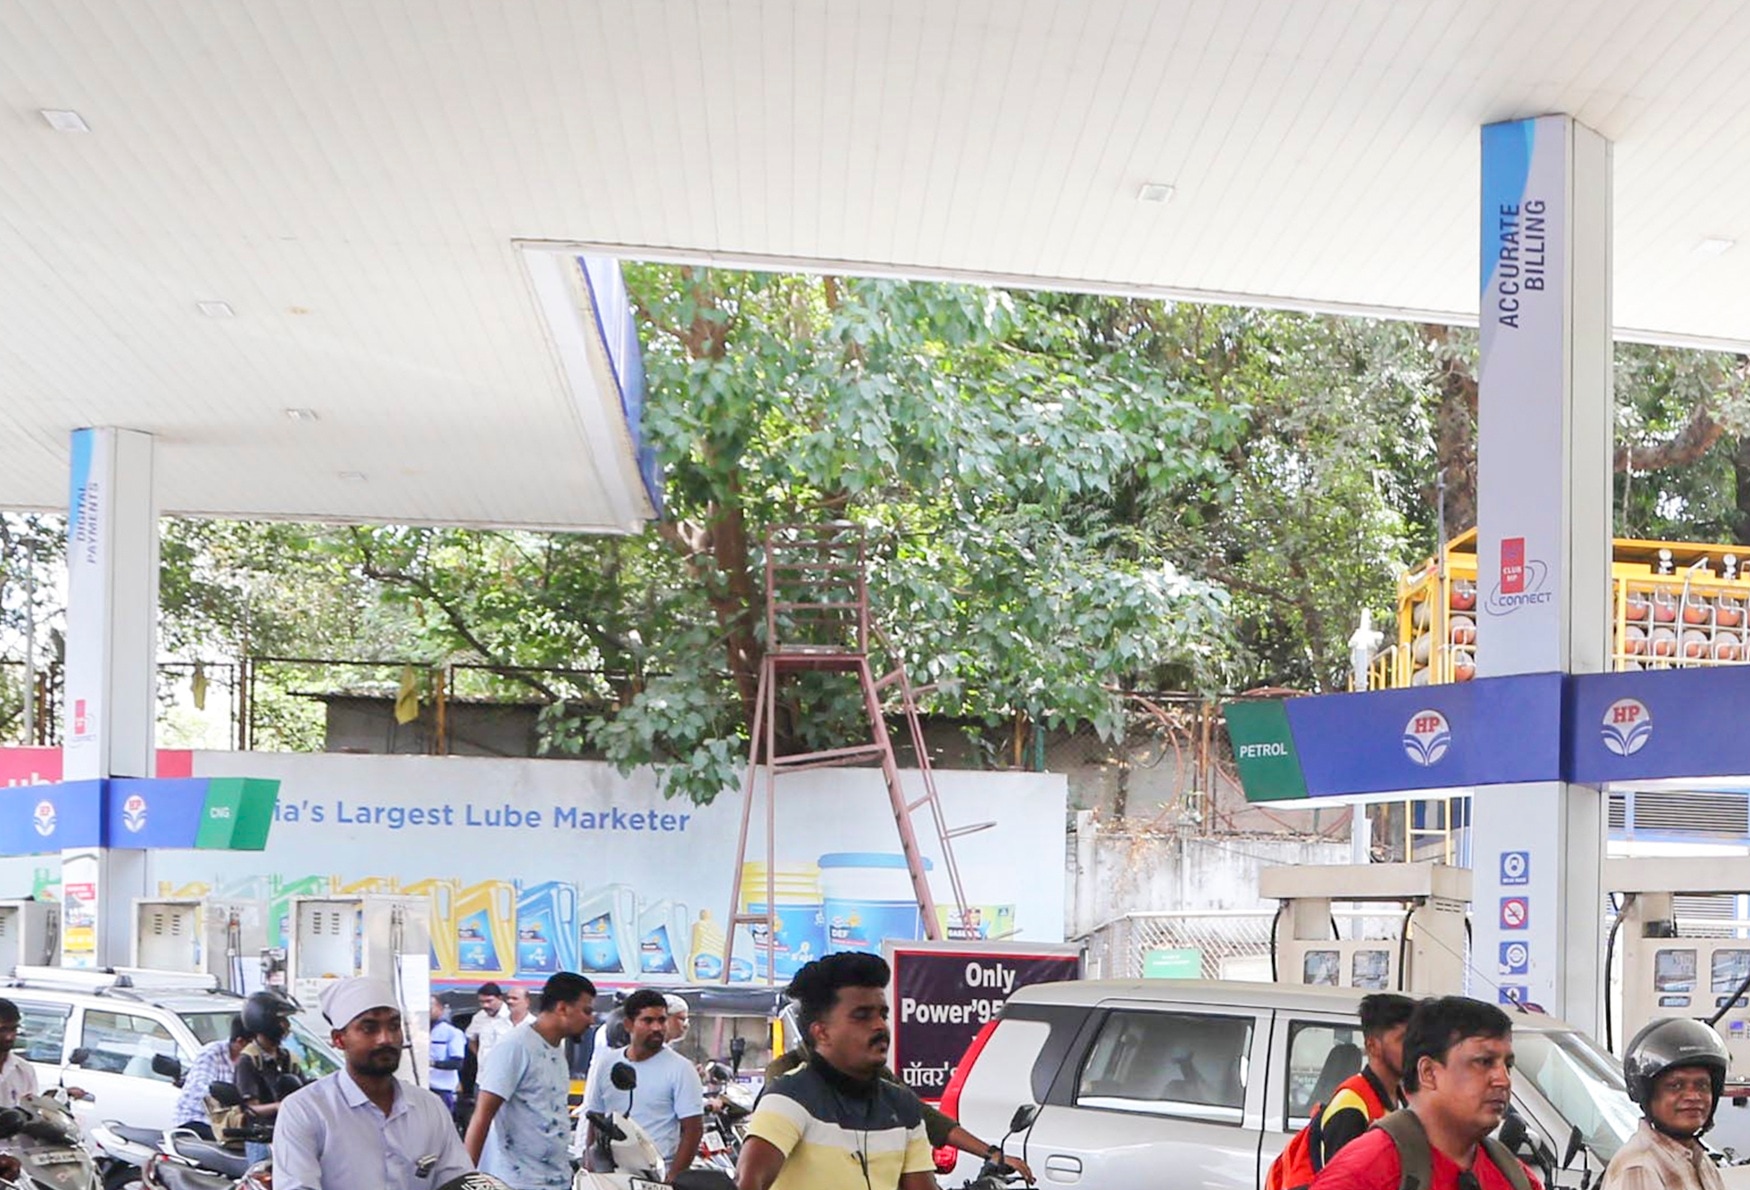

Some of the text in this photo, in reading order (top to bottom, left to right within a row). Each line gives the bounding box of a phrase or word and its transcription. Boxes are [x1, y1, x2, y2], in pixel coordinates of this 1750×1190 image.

[1524, 200, 1546, 291] BILLING
[1498, 204, 1520, 329] ACCURATE
[1414, 716, 1441, 734] HP
[1612, 705, 1641, 724] HP
[1239, 742, 1288, 759] PETROL
[209, 807, 231, 819] CNG
[336, 802, 454, 829] Largest
[465, 804, 542, 828] Lube
[554, 807, 691, 832] Marketer
[965, 962, 1017, 994] Only
